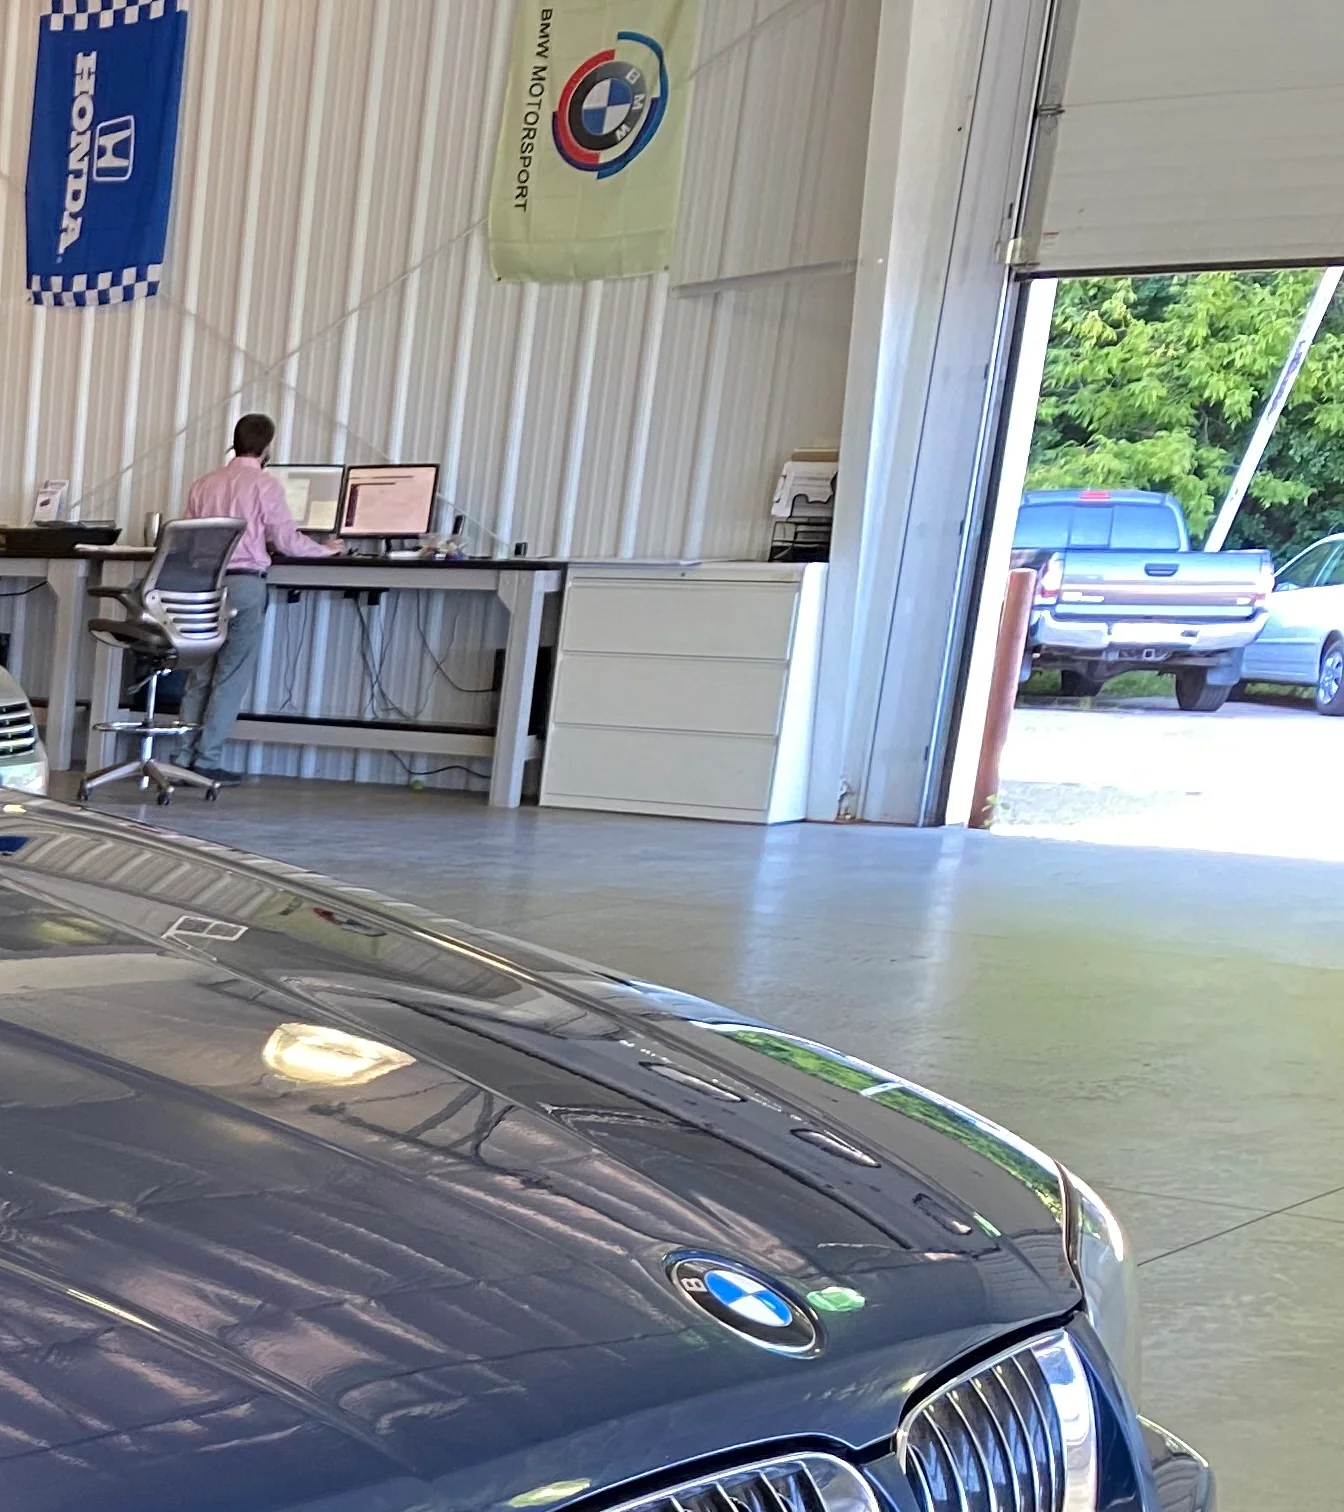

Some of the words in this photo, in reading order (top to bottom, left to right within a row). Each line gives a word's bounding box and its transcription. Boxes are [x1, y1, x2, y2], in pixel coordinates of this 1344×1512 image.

[536, 8, 553, 59] BMW
[57, 51, 97, 254] HONDA
[514, 65, 548, 212] MOTORSPORT
